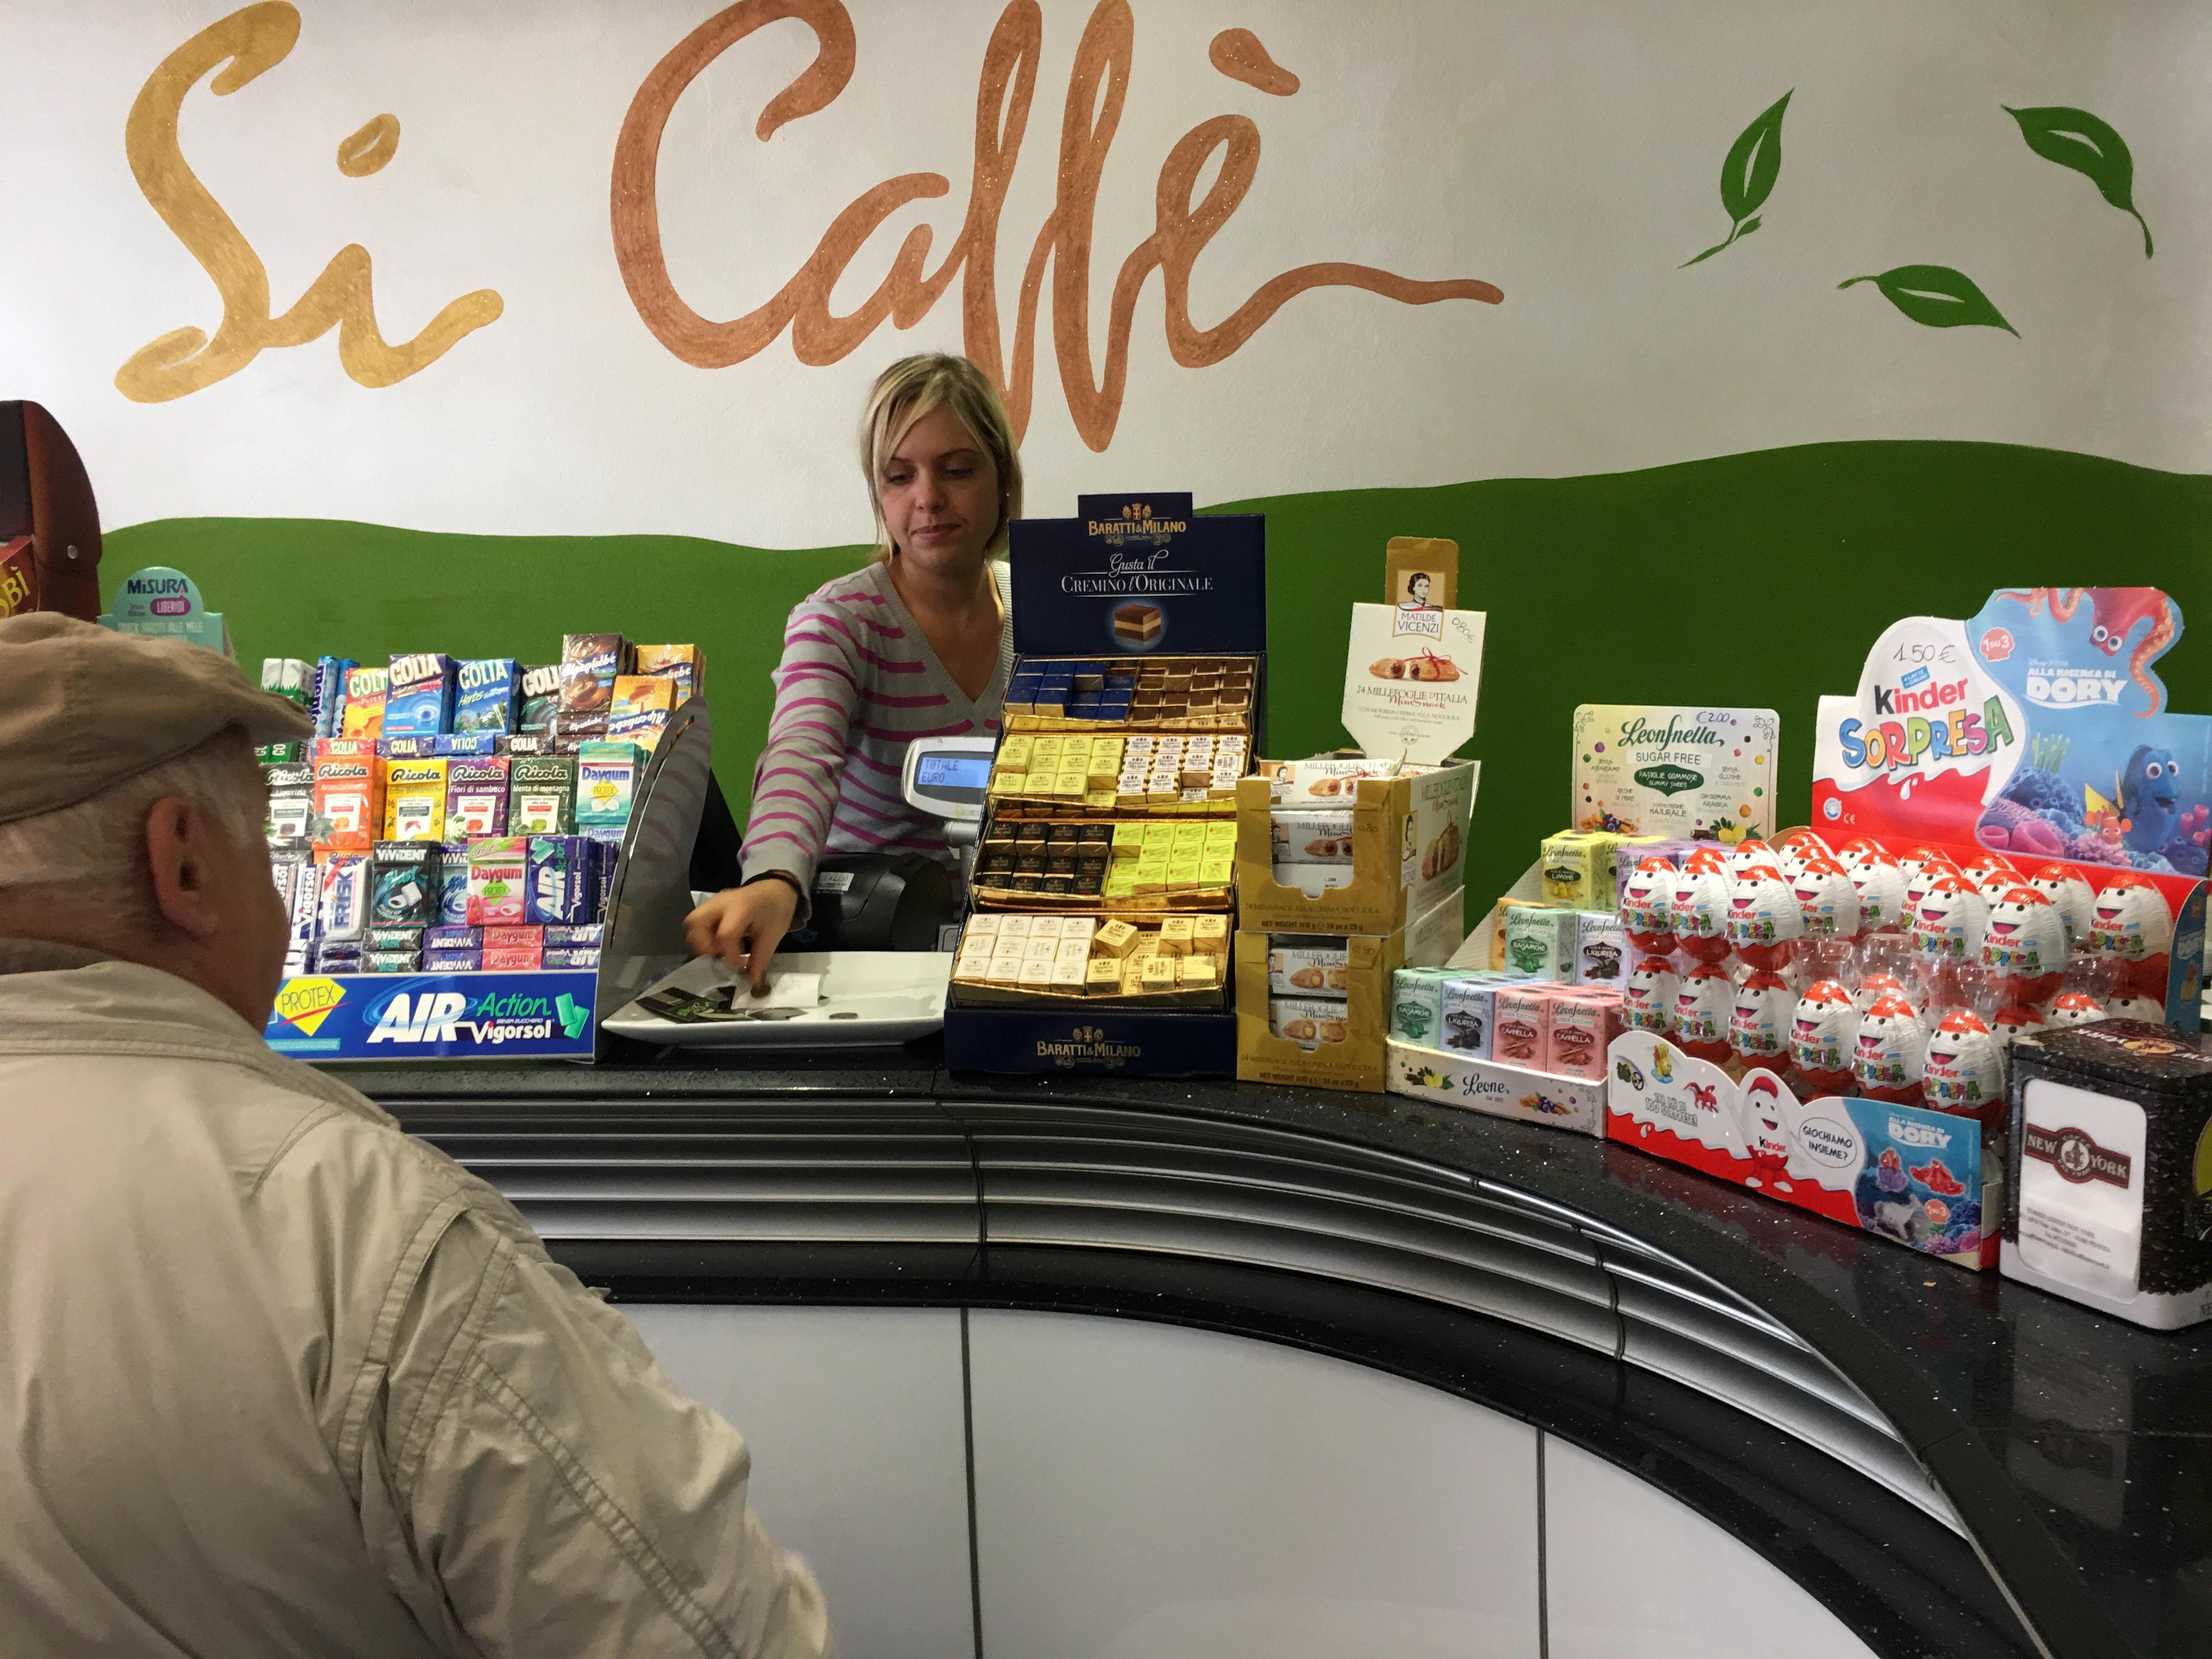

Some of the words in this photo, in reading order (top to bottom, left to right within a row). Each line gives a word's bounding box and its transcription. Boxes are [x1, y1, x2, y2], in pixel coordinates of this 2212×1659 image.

[114, 0, 504, 404] Si
[611, 0, 1503, 452] Caffè
[1108, 553, 1144, 578] Gusta
[1147, 549, 1169, 571] il
[1061, 576, 1126, 593] CREMINO
[1398, 620, 1439, 634] VICENZI
[1401, 612, 1436, 622] MATILDE
[311, 664, 325, 727] mento
[1357, 686, 1365, 694] 24
[1367, 686, 1427, 700] MILLEFOGLIE
[2026, 676, 2129, 702] DORY
[1839, 695, 2015, 771] SORPRESA
[926, 759, 959, 771] TOTALE
[1636, 752, 1671, 763] SUGAR
[1674, 752, 1701, 765] FREE
[317, 763, 368, 780] Ricola
[391, 768, 441, 782] Ricola
[452, 765, 505, 781] Ricola
[515, 765, 568, 780] Ricola
[582, 768, 630, 784] Daygum
[921, 772, 945, 783] EURO
[593, 786, 614, 795] PROTEX
[1297, 822, 1351, 831] MILLEFOGLI
[470, 838, 503, 859] Gel
[471, 866, 522, 883] Daygum
[299, 867, 317, 929] Vigorsol
[334, 871, 354, 929] FRISK
[537, 866, 566, 921] AIR
[281, 985, 336, 1014] PROTEX
[477, 992, 552, 1018] Action
[366, 993, 467, 1043] AIR
[469, 1019, 551, 1045] Vigorsol
[1803, 1126, 1853, 1148] GIOCHIAMO
[1888, 1122, 1953, 1148] DORY
[1809, 1141, 1848, 1161] INSIEME?
[2028, 1135, 2058, 1154] NEW
[2090, 1155, 2127, 1178] YORK
